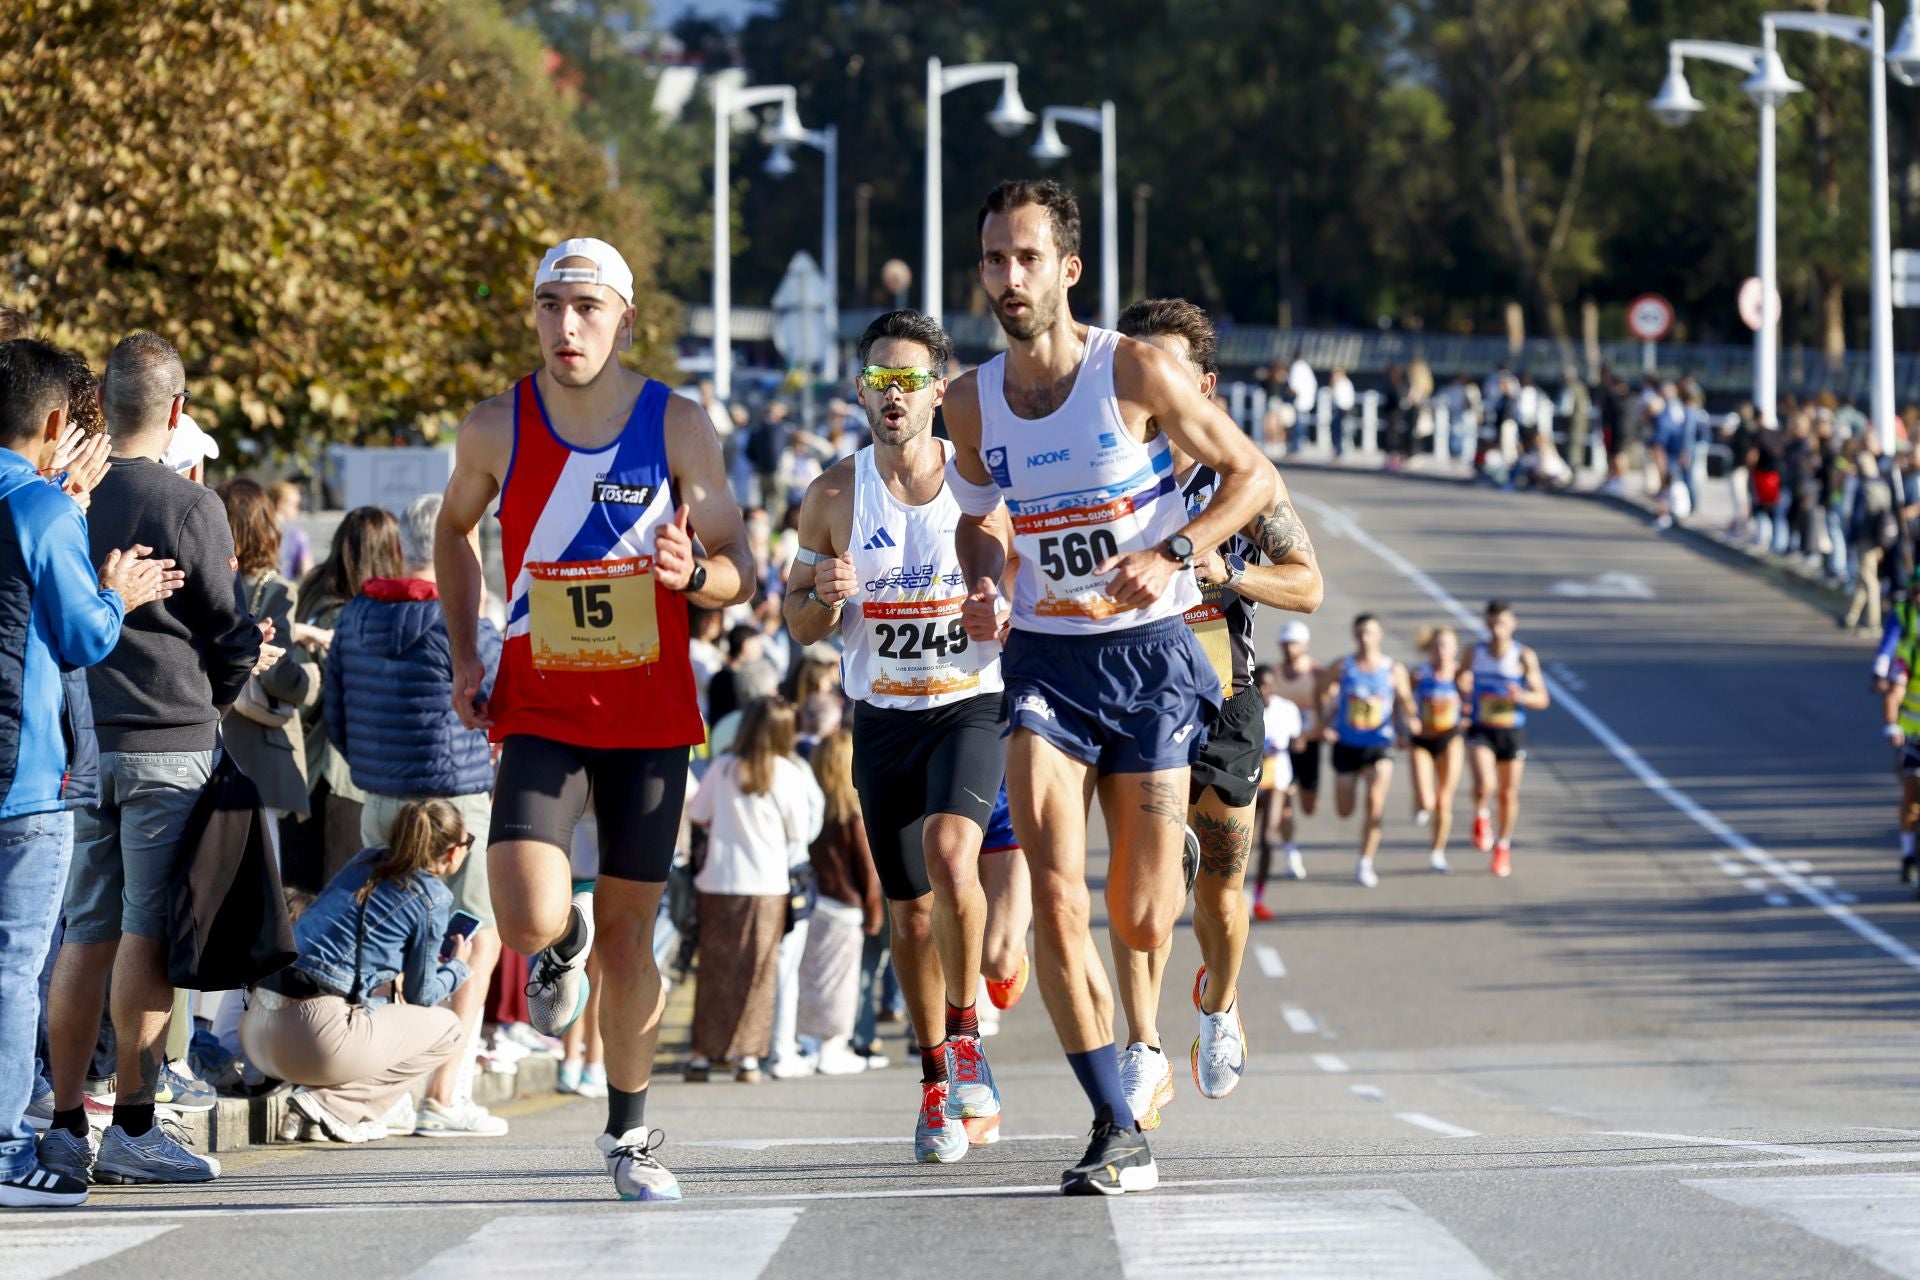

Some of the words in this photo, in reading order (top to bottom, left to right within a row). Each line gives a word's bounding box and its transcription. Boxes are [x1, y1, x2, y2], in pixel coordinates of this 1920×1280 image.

[1027, 449, 1071, 468] NOONE
[597, 484, 649, 504] Toscaf
[1045, 516, 1069, 527] MBA
[1088, 509, 1116, 520] GIJÓN
[1039, 529, 1118, 582] 560
[560, 567, 587, 576] MBA
[607, 563, 634, 573] GIJÓN
[891, 564, 934, 577] CLUB
[566, 584, 613, 628] 15
[897, 607, 919, 615] MBA
[1184, 609, 1209, 620] GIJÓN
[875, 617, 968, 659] 2249
